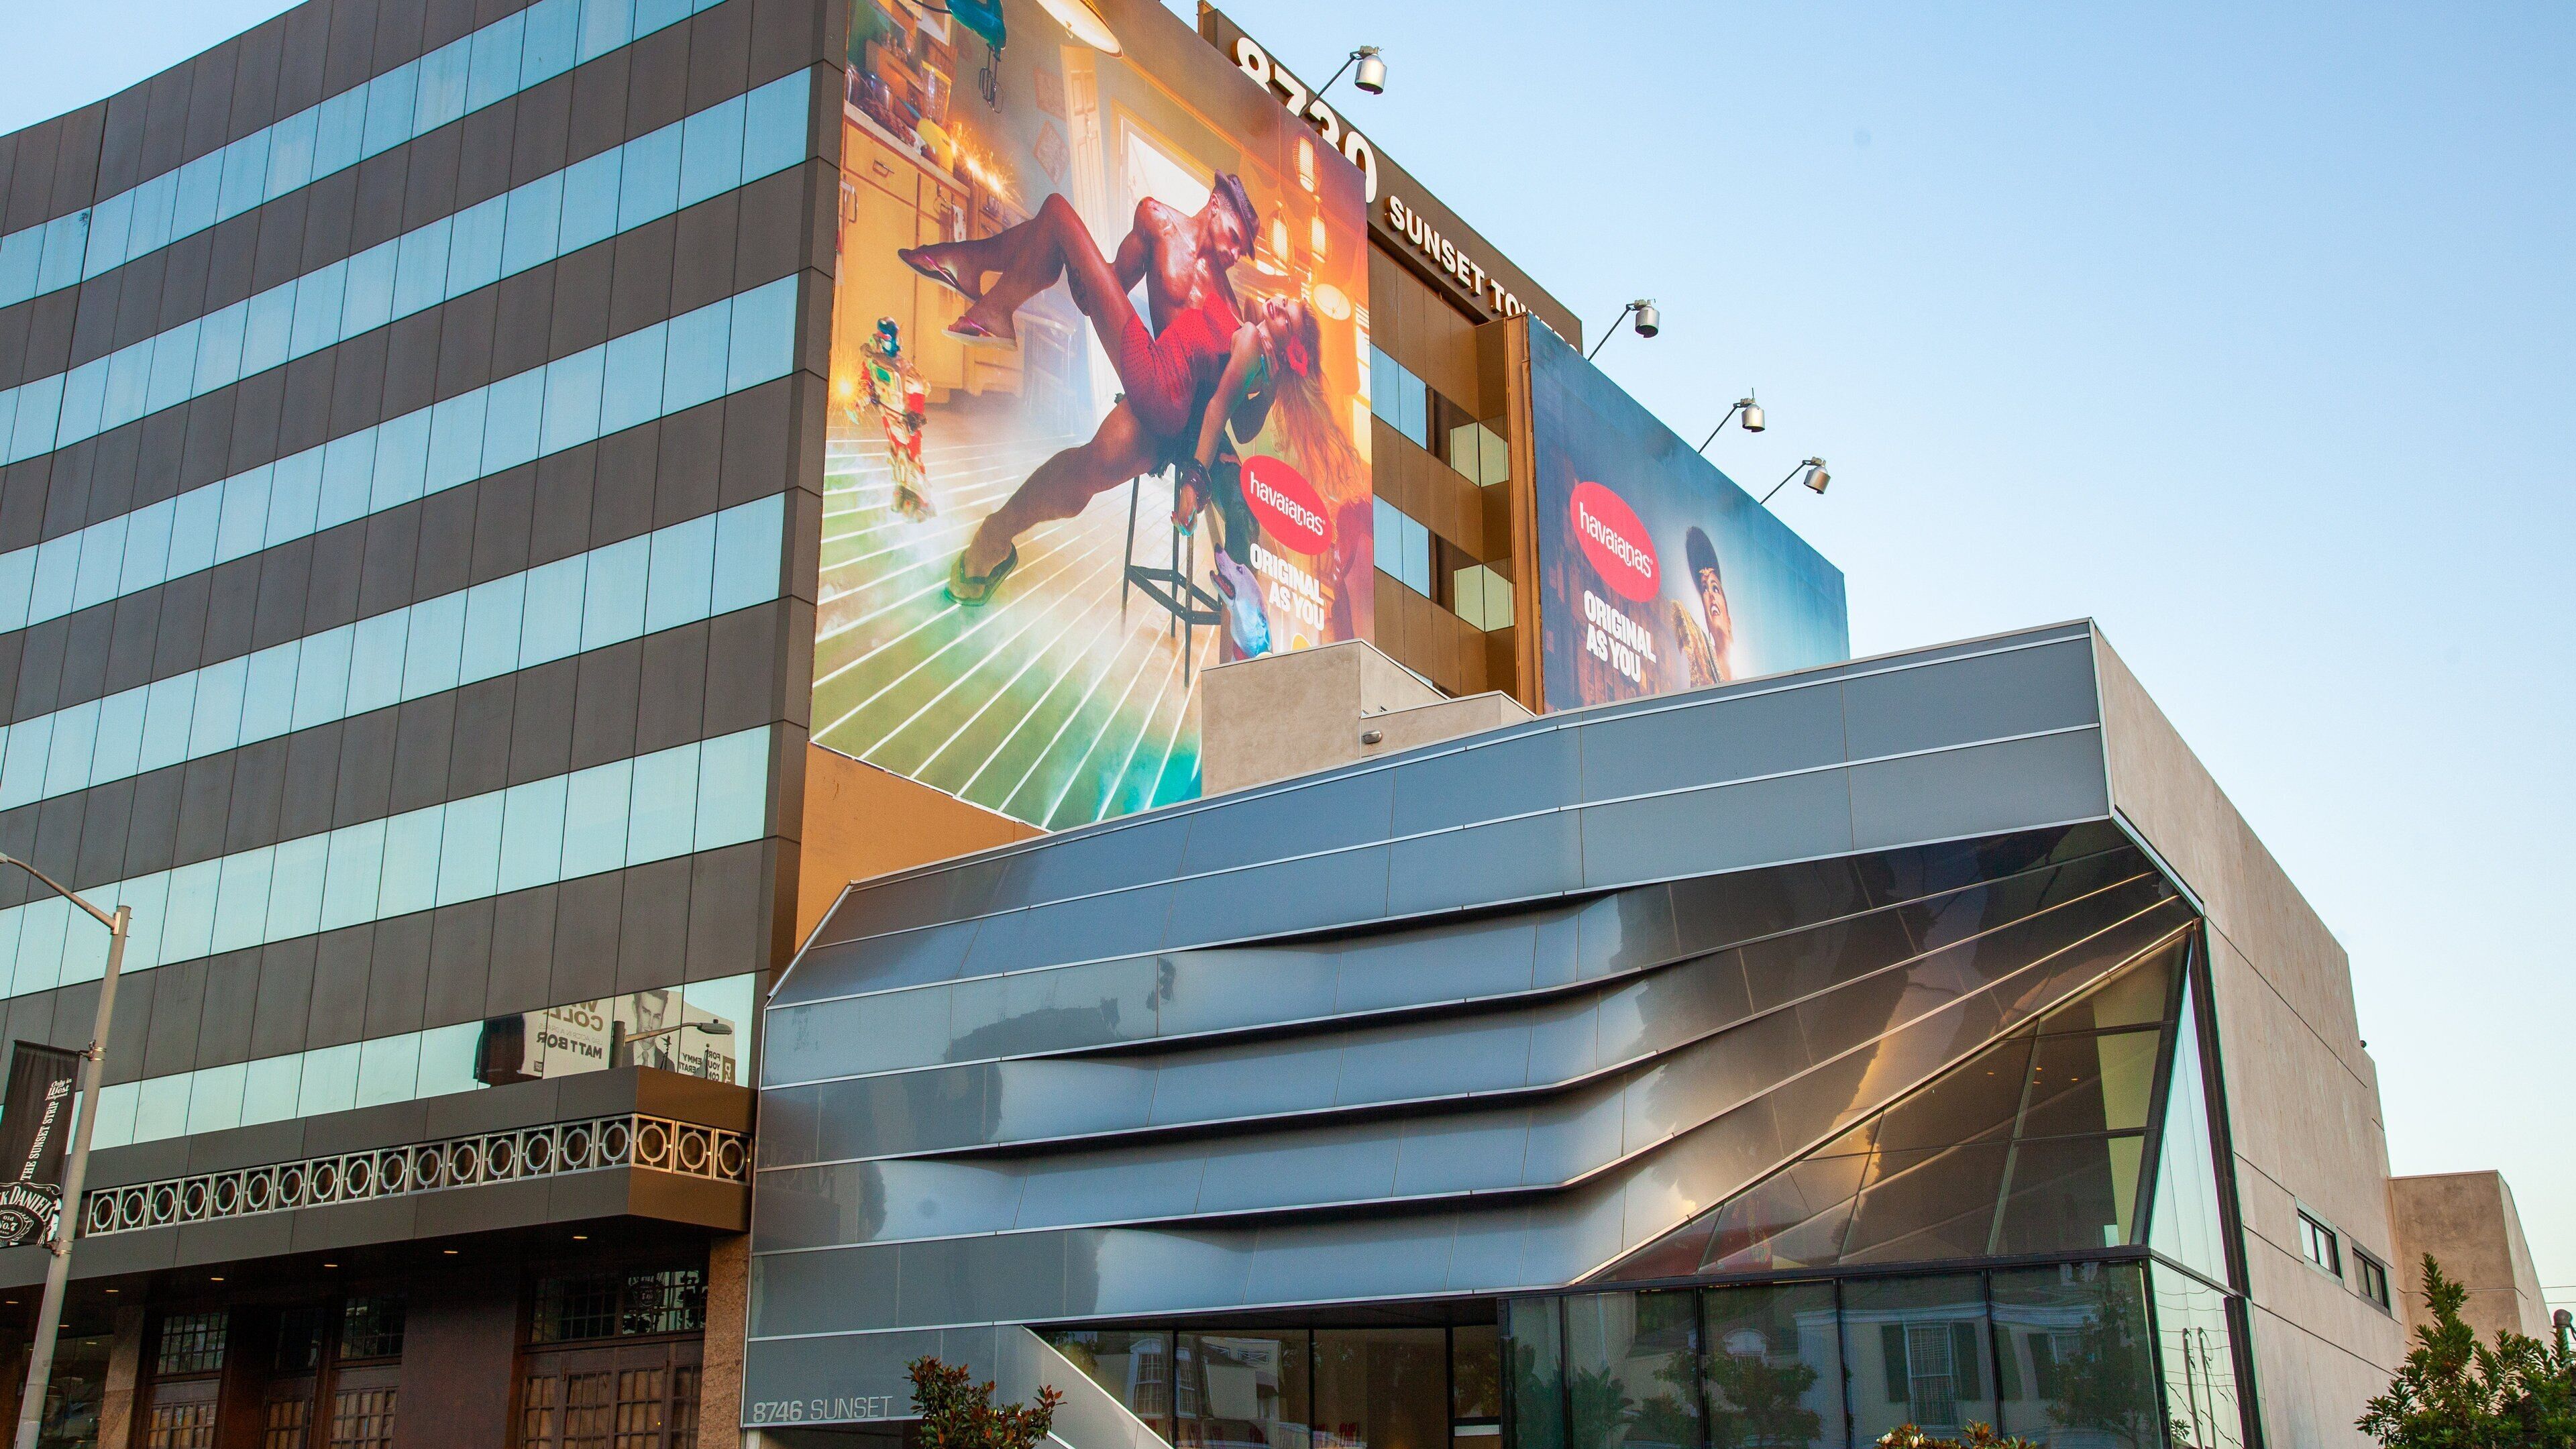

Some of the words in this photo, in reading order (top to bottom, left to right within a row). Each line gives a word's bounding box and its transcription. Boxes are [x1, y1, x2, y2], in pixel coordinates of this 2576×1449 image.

[1386, 195, 1485, 297] SUNSET
[1250, 470, 1324, 536] havaianas
[1579, 501, 1652, 578] havaianas
[1250, 543, 1324, 606] ORIGINAL
[1269, 582, 1291, 612] AS
[1293, 590, 1325, 631] YOU
[1583, 590, 1656, 663] ORIGINAL
[1587, 624, 1608, 663] AS
[1608, 637, 1642, 683] YOU
[48, 1085, 70, 1096] West
[20, 1161, 36, 1181] THE
[29, 1126, 50, 1161] SUNSET
[43, 1100, 60, 1126] STRIP
[753, 1399, 804, 1424] 8746
[810, 1395, 894, 1421] SUNSET
